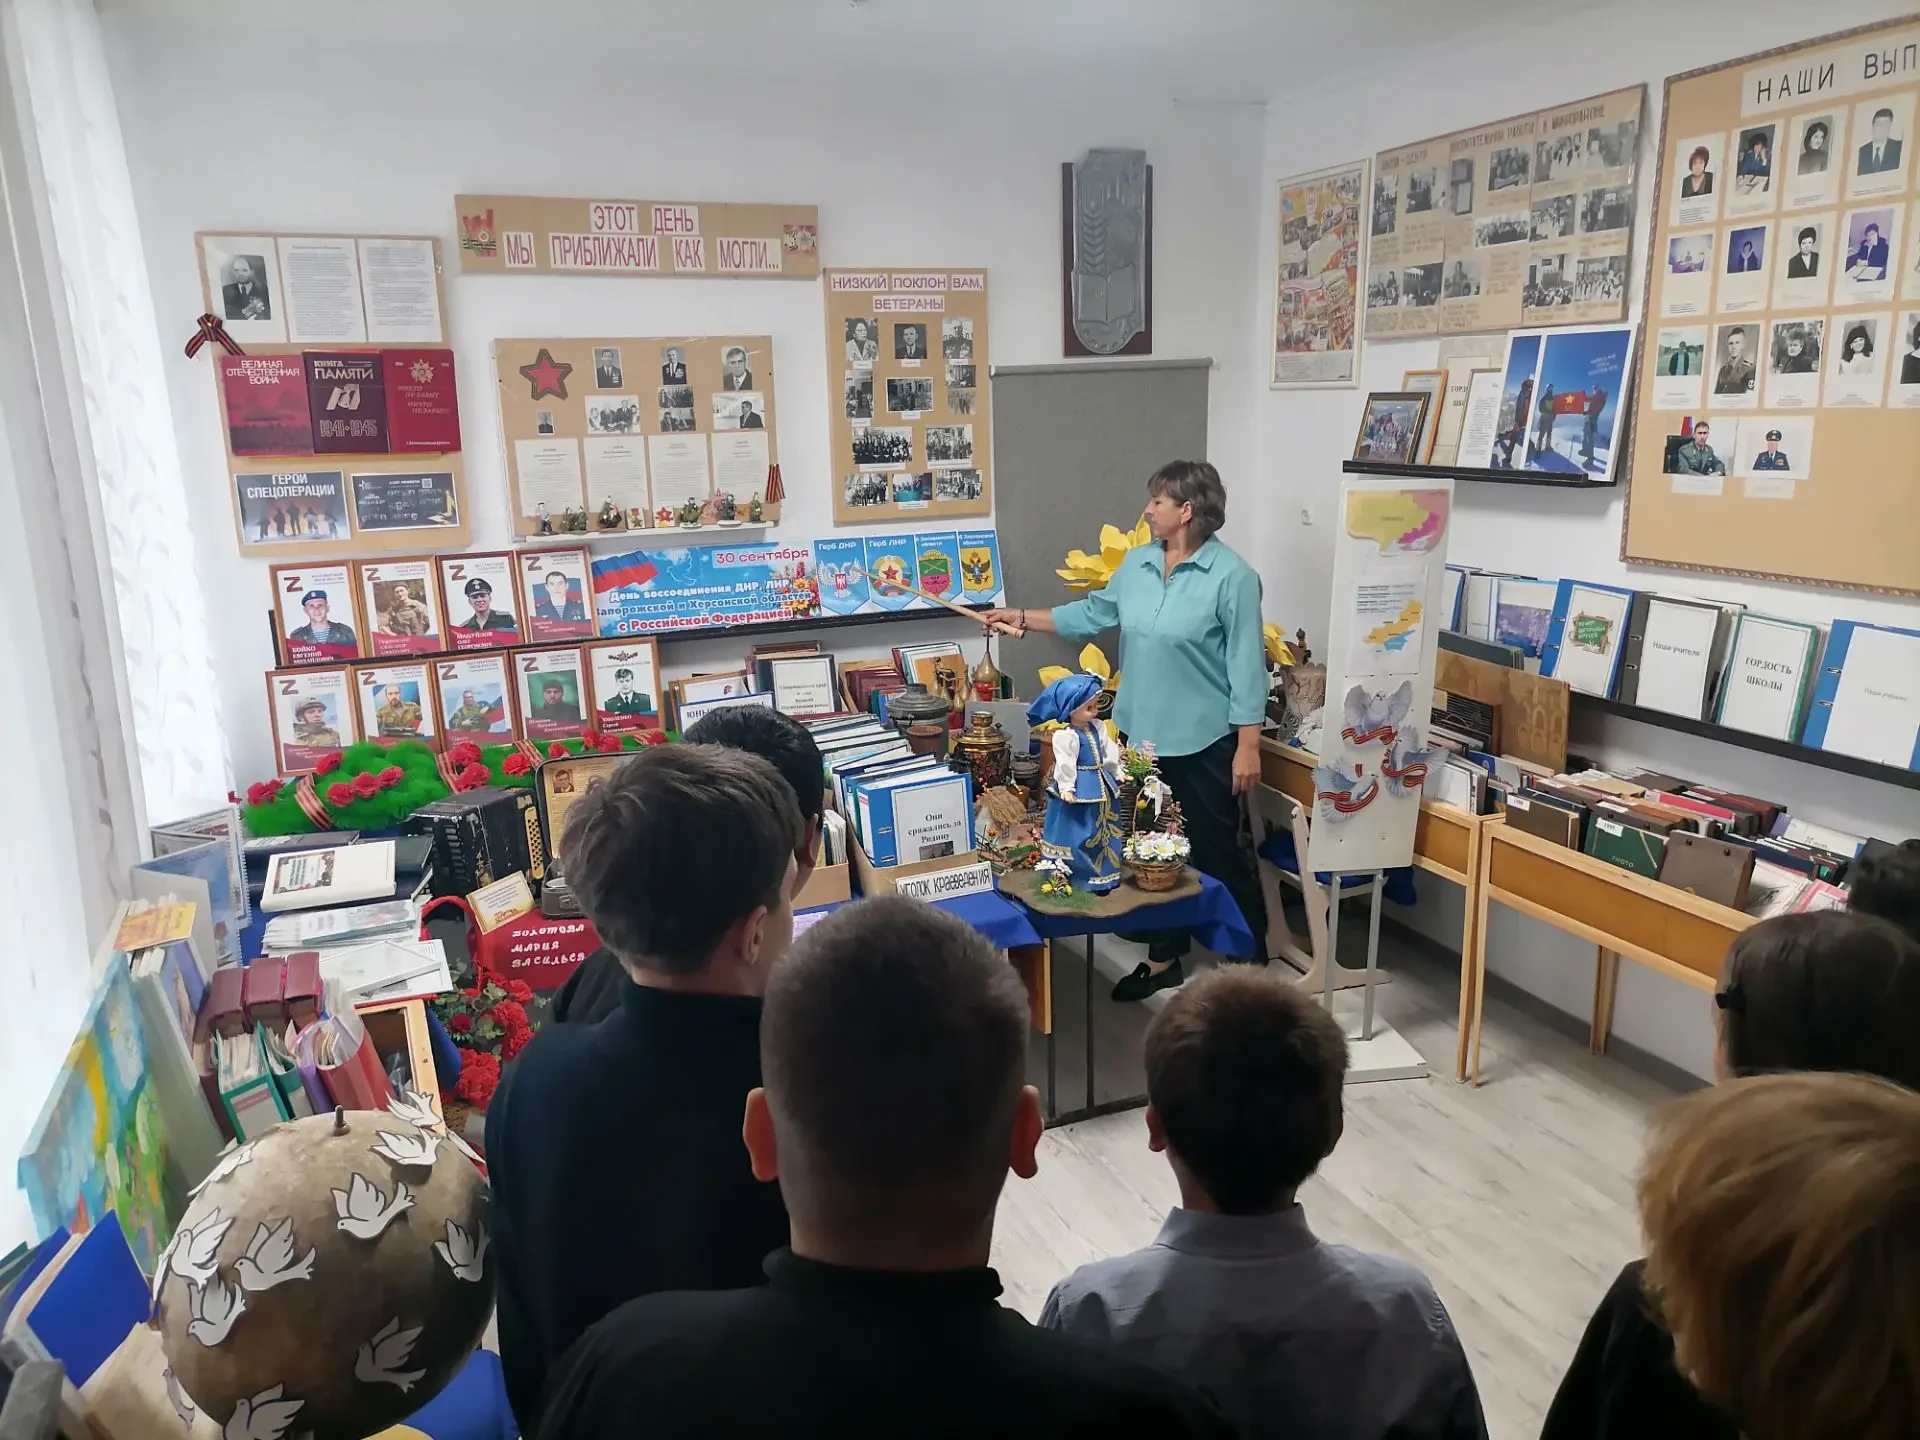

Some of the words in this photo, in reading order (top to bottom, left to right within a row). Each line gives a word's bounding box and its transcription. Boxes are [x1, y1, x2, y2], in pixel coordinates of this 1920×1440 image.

[1757, 62, 1835, 104] НАШИ
[1864, 43, 1918, 80] ВЫП
[593, 205, 636, 232] ЭТОТ
[653, 206, 695, 234] ДЕНЬ
[505, 234, 533, 266] МЫ
[551, 236, 658, 269] ПРИБЛИЖАЛИ
[674, 238, 703, 269] КАК
[832, 274, 888, 289] НИЗКИЙ
[893, 277, 946, 289] ПОКЛОН
[952, 277, 983, 290] ВАМ,
[874, 298, 944, 310] ВЕТЕРАНЫ
[313, 360, 344, 368] КНИГА
[226, 368, 300, 377] ОТЕЧЕСТВЕННАЯ
[249, 376, 280, 385] ВОЙНА
[314, 368, 374, 380] ПАМЯТИ
[271, 473, 308, 485] ГЕРОИ
[246, 484, 336, 500] СПЕЦОПЕРАЦИИ
[818, 543, 837, 551] Герб
[837, 541, 857, 550] ДНР
[716, 552, 735, 564] 30
[738, 547, 810, 563] сентября
[609, 591, 640, 604] День
[643, 585, 732, 600] воссоединения
[734, 580, 763, 594] ДНР,
[678, 602, 687, 611] и
[689, 594, 758, 610] Херсонской
[761, 590, 813, 604] областей
[618, 623, 627, 632] с
[630, 615, 710, 631] Российской
[711, 607, 794, 625] Федерацией
[1744, 656, 1793, 675] ГОРДОСТЬ
[1746, 675, 1783, 692] ШКОЛЫ
[925, 813, 943, 822] Они
[907, 823, 951, 836] сражались
[953, 820, 962, 828] за
[921, 833, 950, 844] Родину
[1611, 855, 1634, 868] PHOTO
[510, 940, 560, 953] МАРИЯ
